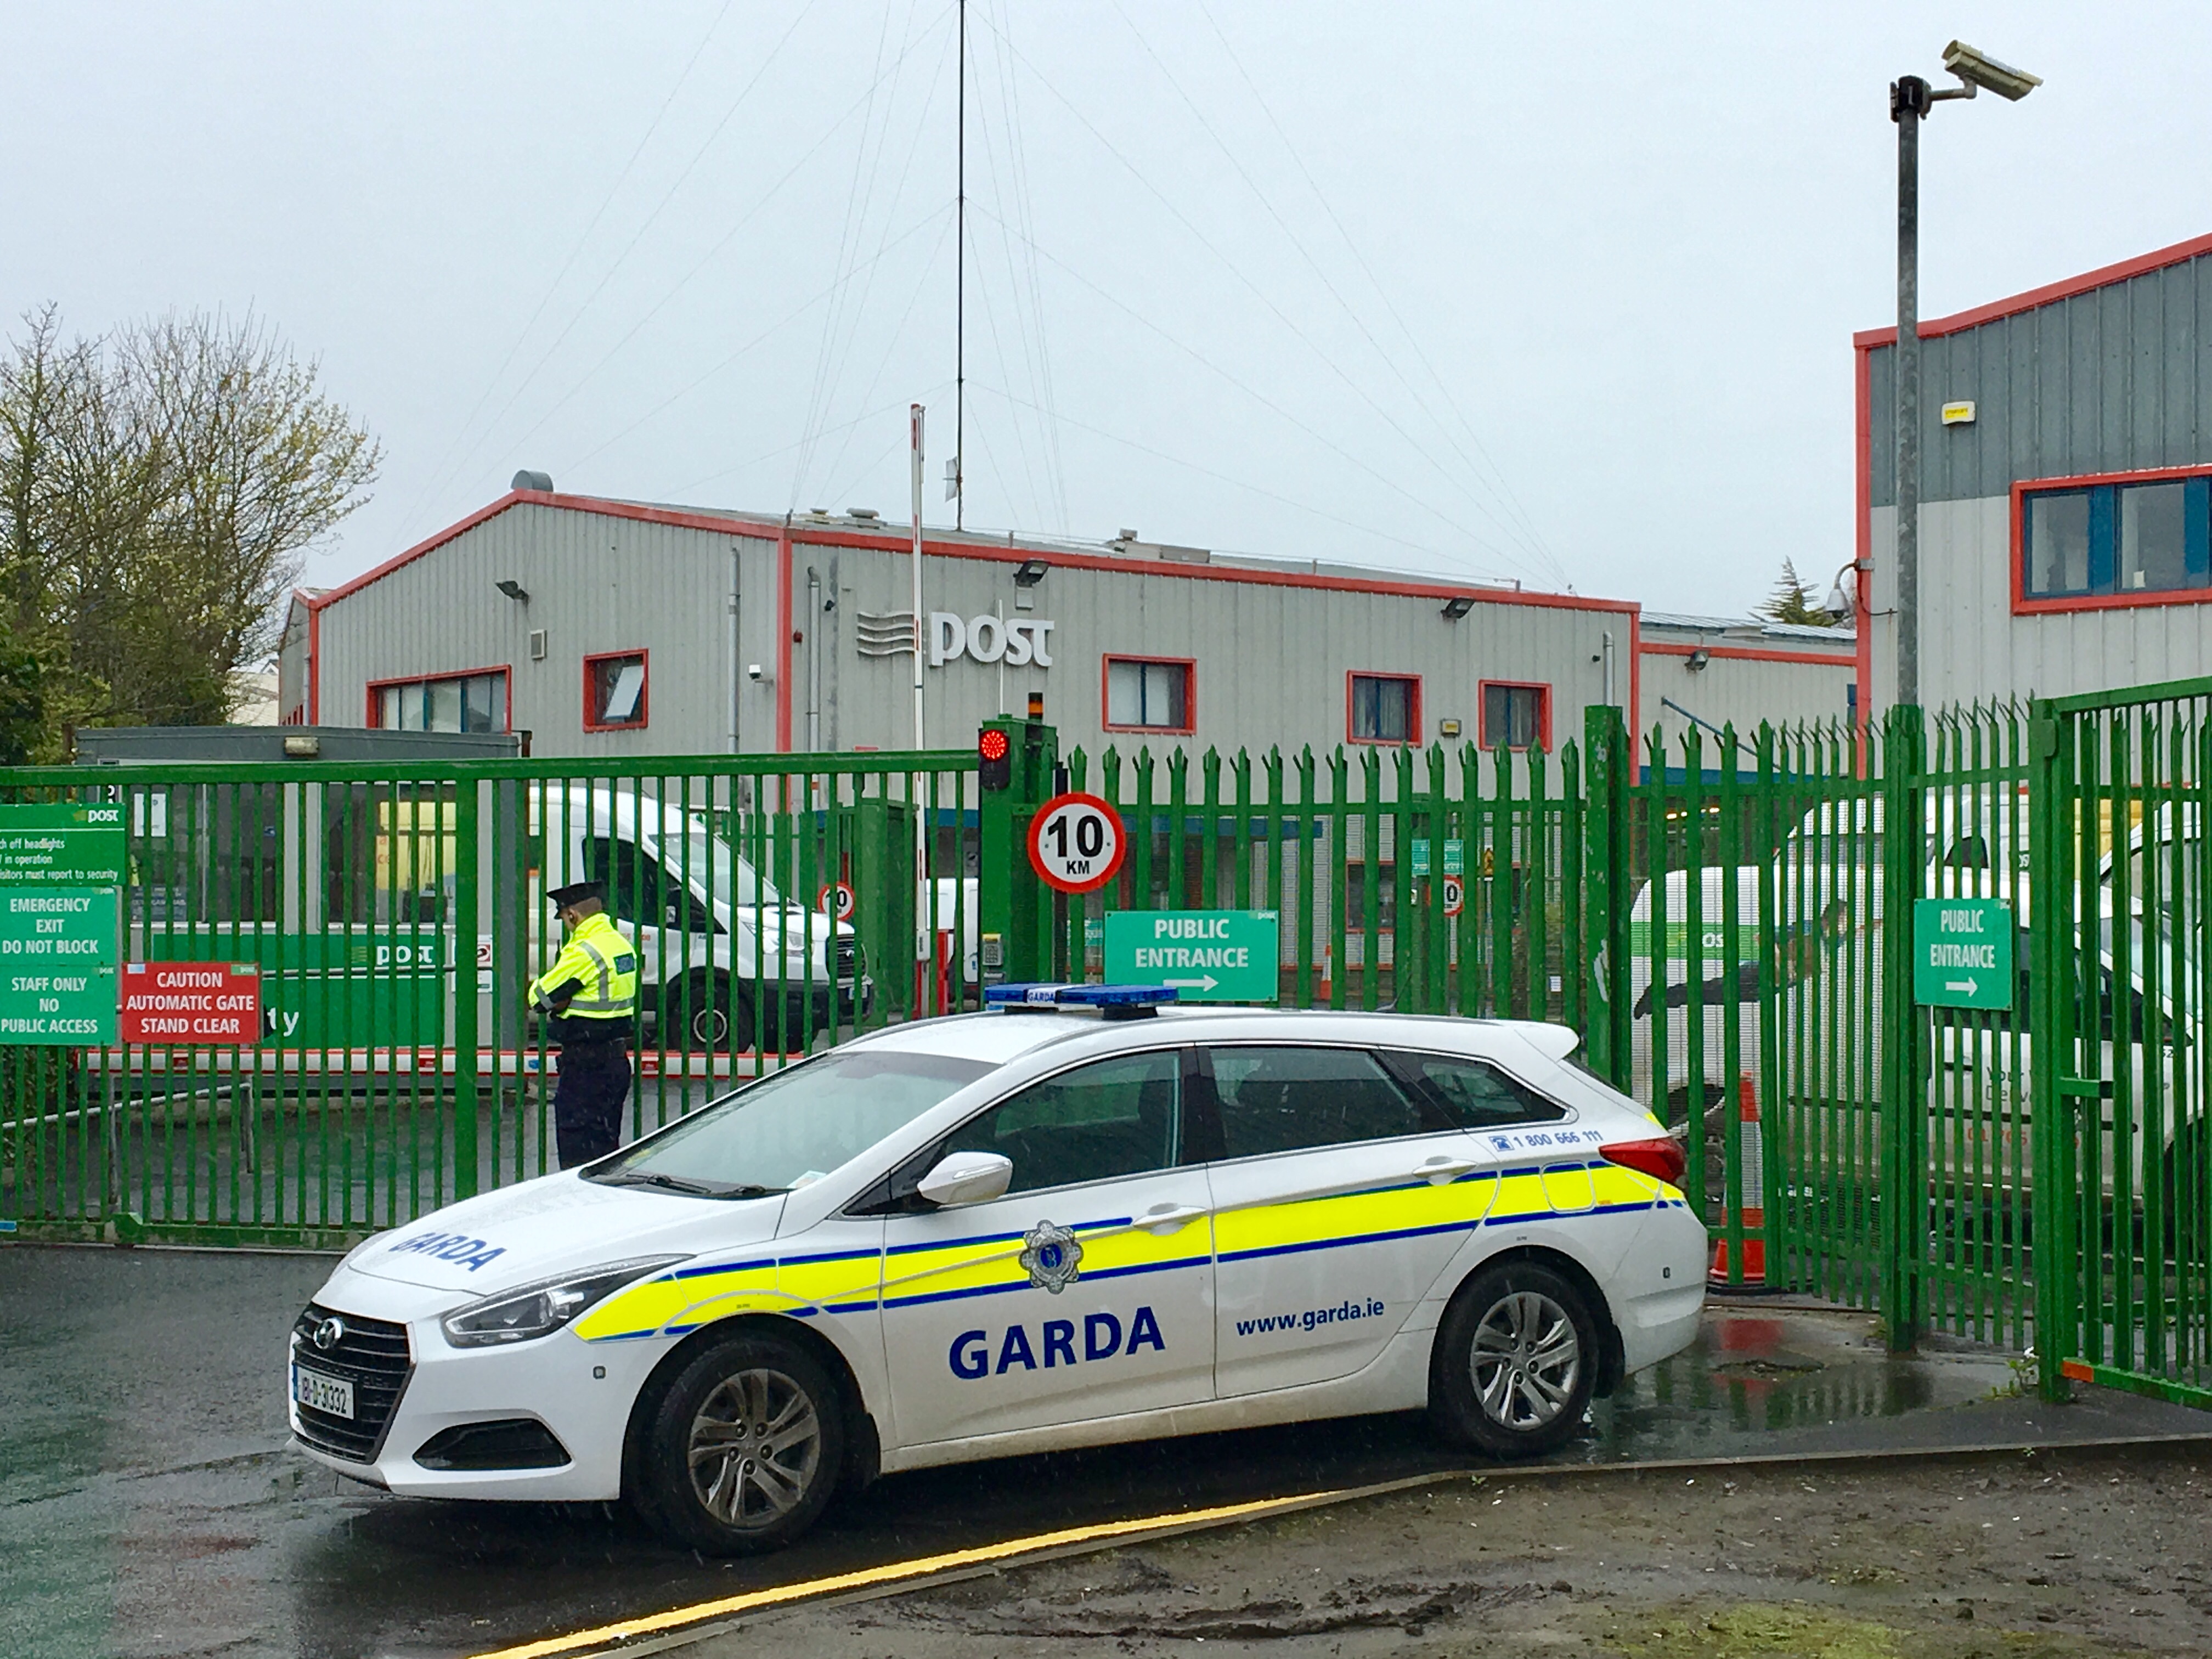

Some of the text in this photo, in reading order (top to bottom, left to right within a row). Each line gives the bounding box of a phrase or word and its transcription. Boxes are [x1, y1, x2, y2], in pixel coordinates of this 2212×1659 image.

[1047, 815, 1103, 857] 10
[25, 838, 65, 851] headlights
[14, 854, 53, 867] operation
[1066, 860, 1090, 874] KM
[0, 868, 119, 882] isitors must report to security
[10, 898, 91, 912] EMERGENCY
[36, 918, 65, 933] EXIT
[1154, 918, 1230, 939] PUBLIC
[1940, 909, 1984, 933] PUBLIC
[2, 939, 99, 954] DO NOT BLOCK
[1135, 947, 1249, 968] ENTRANCE
[1930, 944, 1996, 969] ENTRANCE
[12, 977, 87, 991] STAFF ONLY
[157, 972, 223, 988] CAUTION
[126, 995, 255, 1011] AUTOMATIC GATE
[1028, 992, 1054, 1001] GARDA
[39, 998, 59, 1012] NO
[1, 1018, 98, 1034] PUBLIC ACCESS
[141, 1018, 240, 1033] STAND CLEAR
[1513, 1130, 1604, 1147] 1 800 666 111
[388, 1232, 507, 1272] GARDA
[1236, 1297, 1384, 1336] www.garda.ie
[949, 1306, 1165, 1379] GARDA
